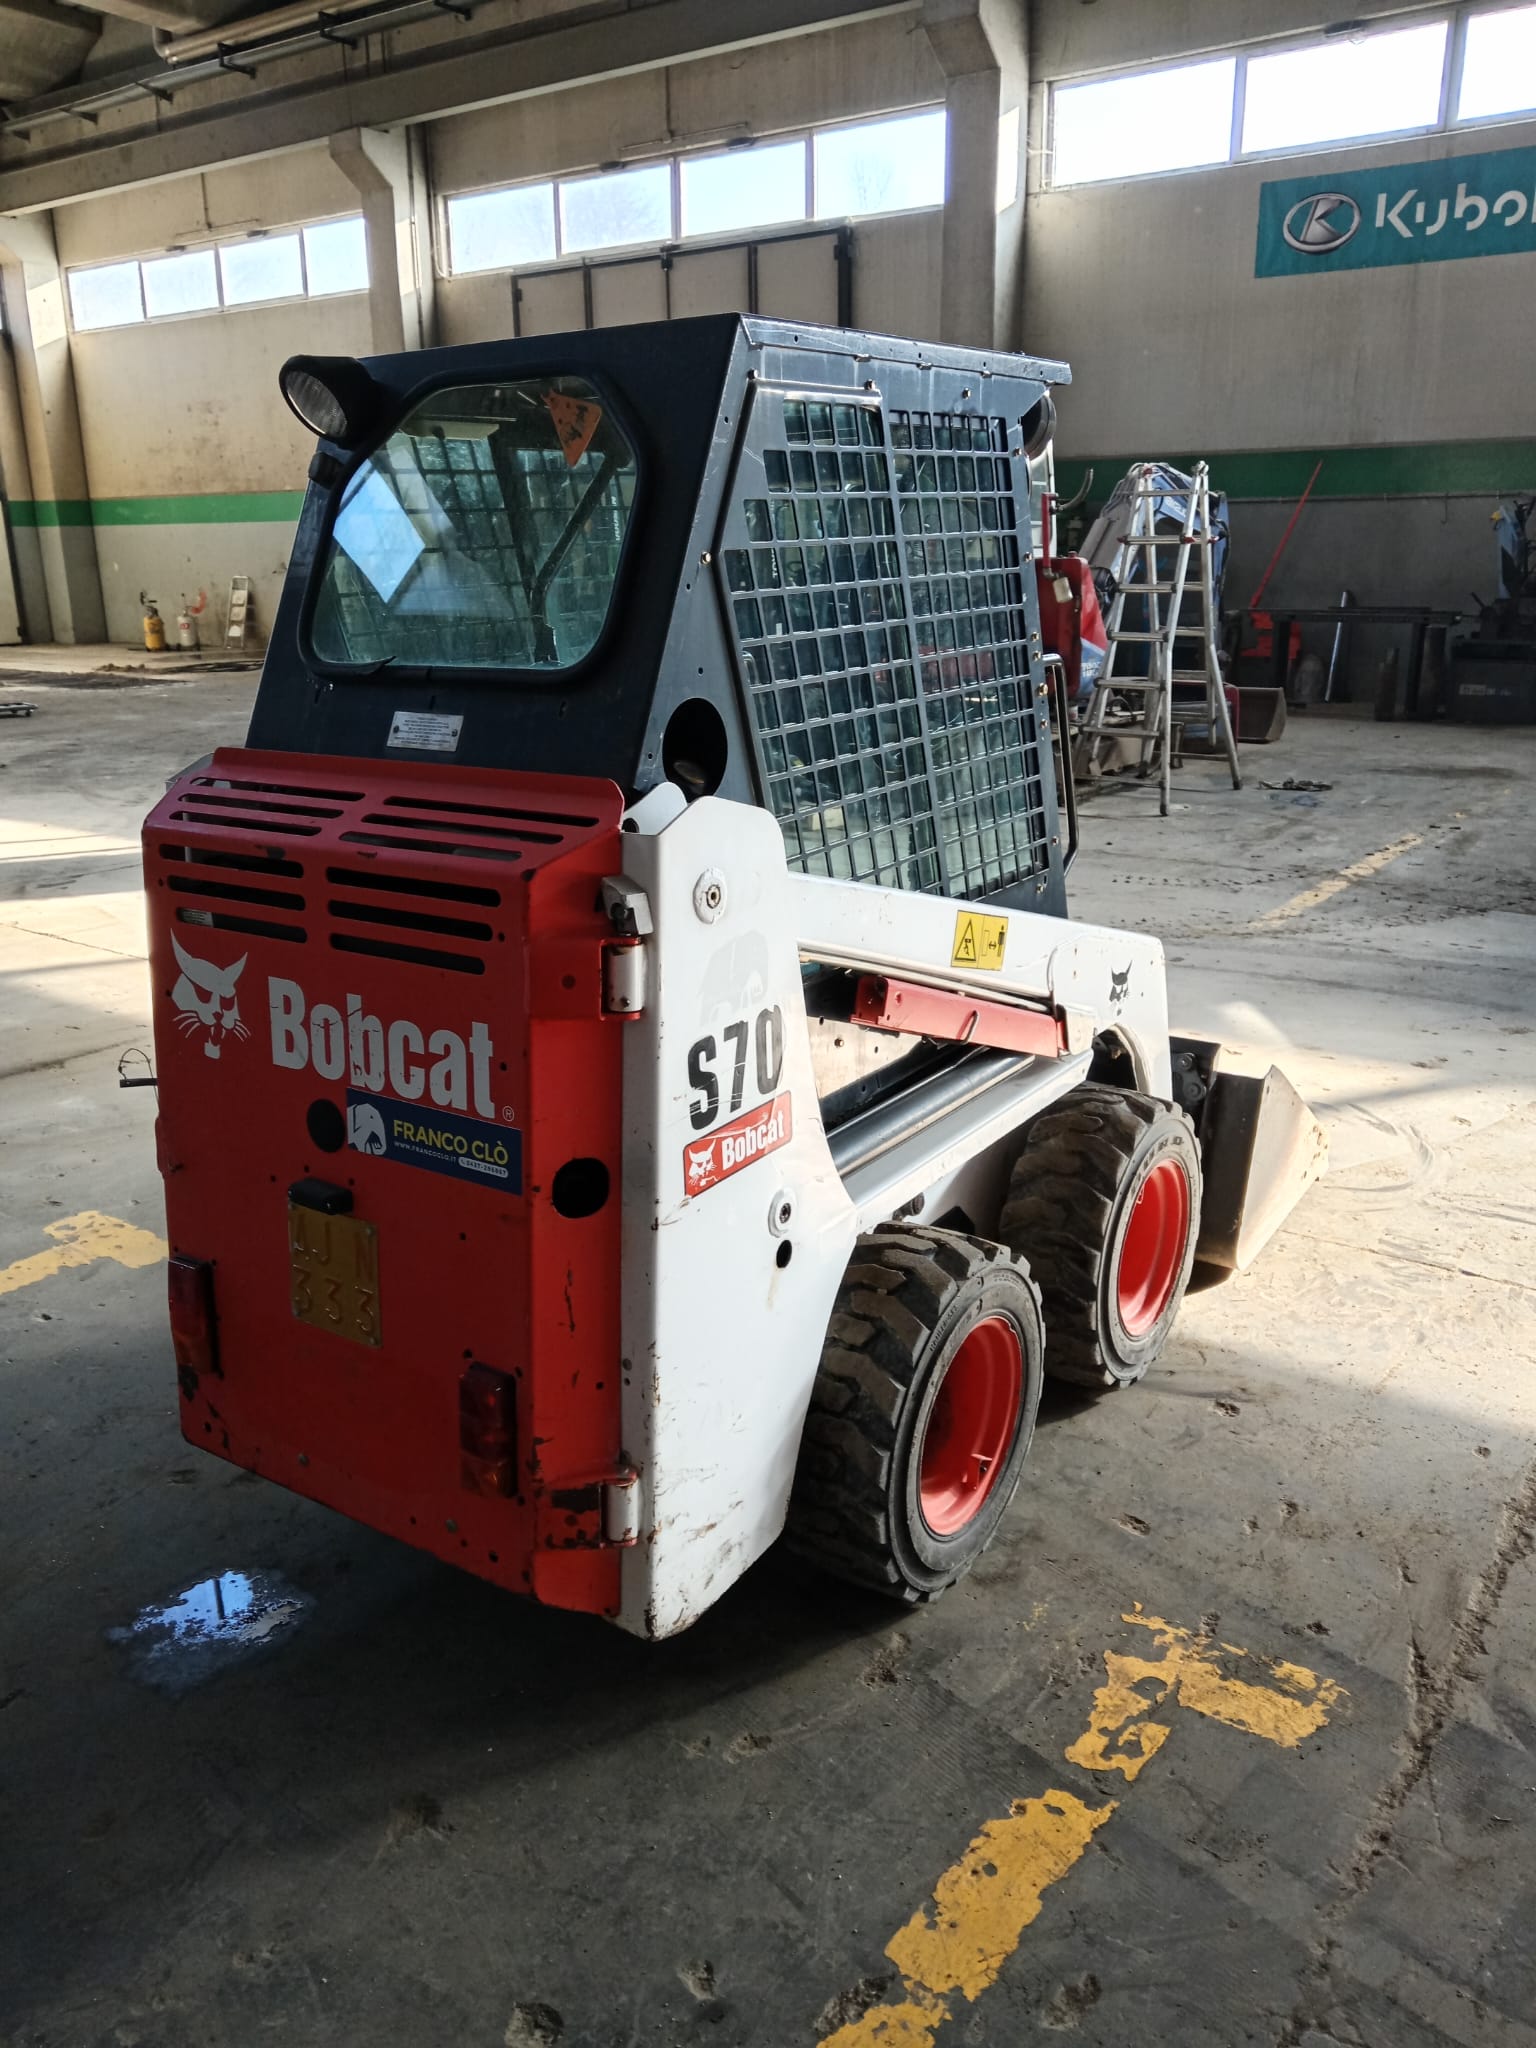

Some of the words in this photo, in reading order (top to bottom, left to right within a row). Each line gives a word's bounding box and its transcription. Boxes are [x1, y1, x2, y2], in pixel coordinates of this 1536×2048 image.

[1375, 183, 1536, 238] Kubo
[268, 976, 495, 1119] Bobcat
[688, 1004, 783, 1131] S70
[393, 1119, 467, 1155] FRANCO
[471, 1140, 509, 1165] CLÒ
[722, 1110, 785, 1170] Bobcat
[291, 1264, 377, 1337] 333
